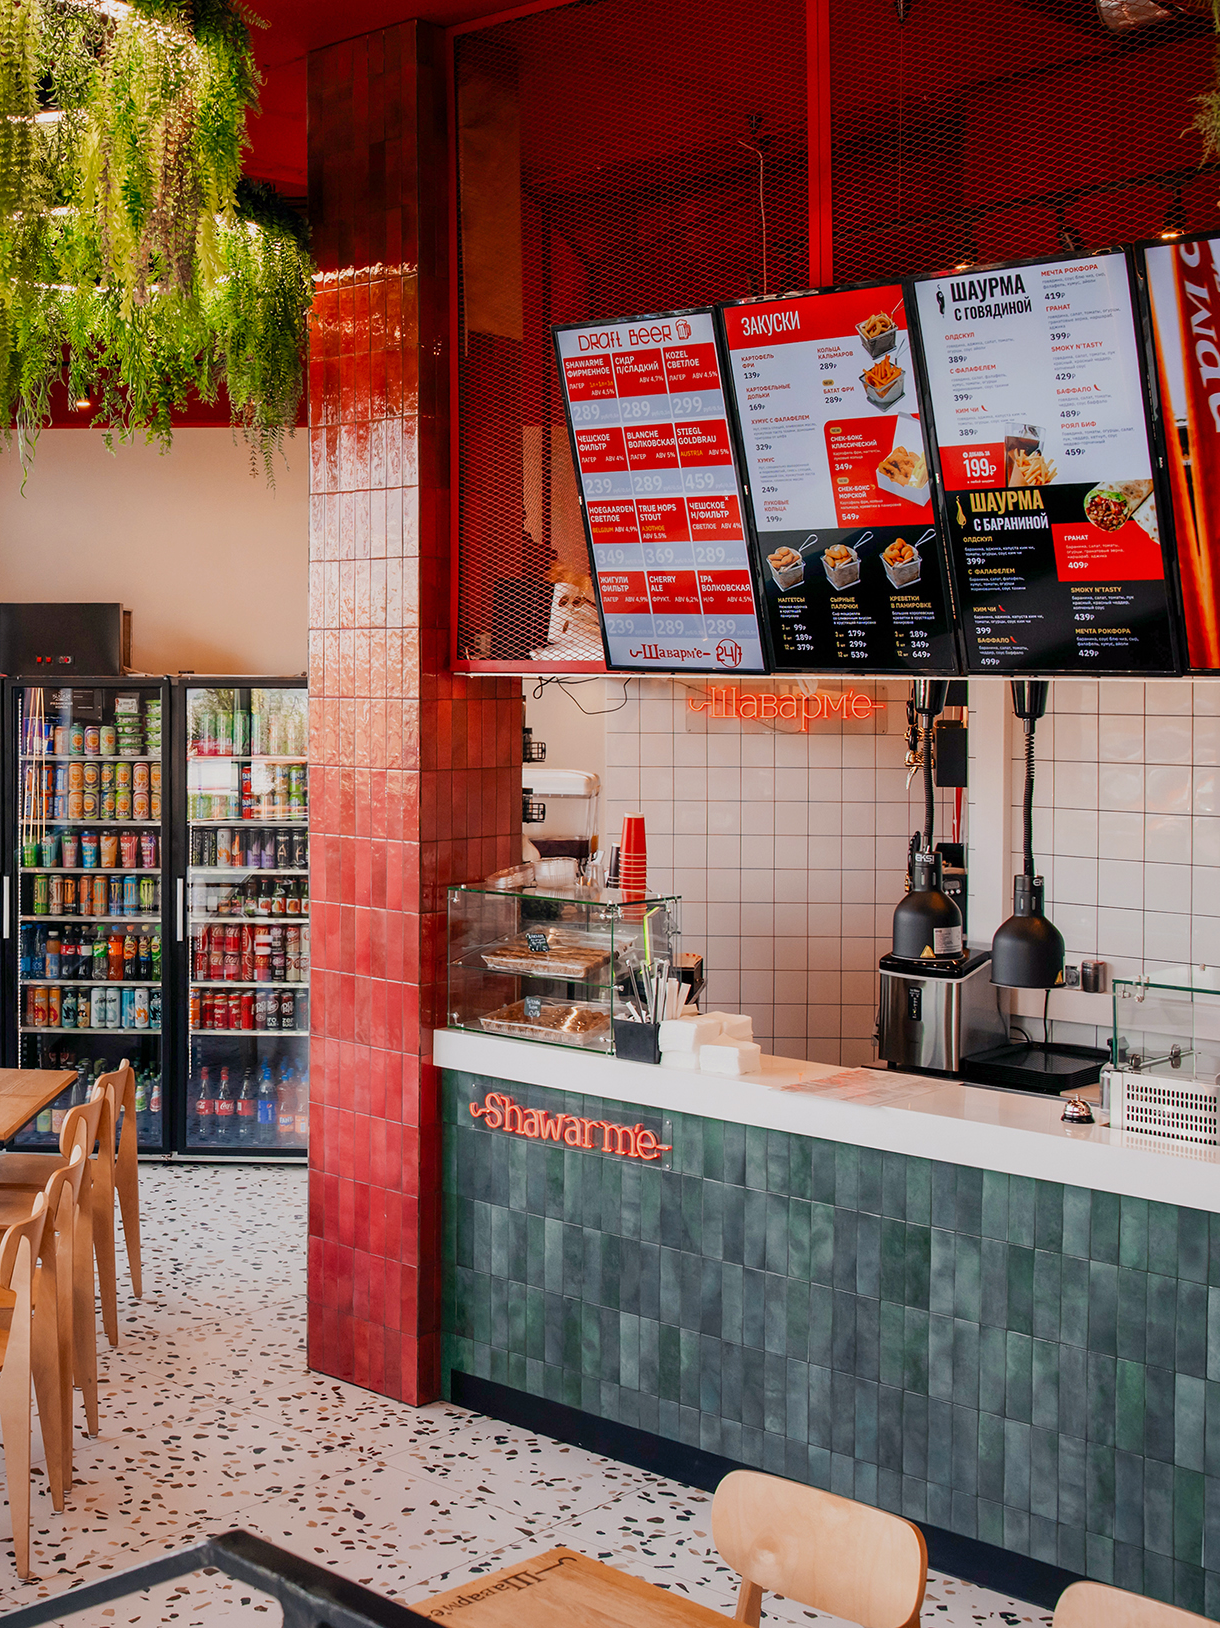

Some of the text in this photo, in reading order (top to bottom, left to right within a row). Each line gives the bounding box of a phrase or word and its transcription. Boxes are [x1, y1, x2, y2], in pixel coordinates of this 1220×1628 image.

[1041, 264, 1098, 277] МЕЧТА РОКФОРА
[950, 274, 1026, 303] ШАУРМА
[954, 308, 962, 321] С
[964, 296, 1032, 320] ГОВЯДИНОЙ
[1046, 304, 1071, 312] ГРАНАТ
[741, 310, 801, 337] ЗАКУСКИ
[945, 332, 975, 341] ОЛДСКУЛ
[817, 346, 841, 354] КОЛЬЦА
[1051, 344, 1074, 352] SMOKY
[615, 356, 635, 365] СИДР
[665, 351, 688, 360] KOZEL
[741, 353, 774, 362] КАРТОФЕЛЬ
[818, 351, 854, 360] КАЛЬМАРОВ
[565, 358, 604, 369] SHAWARME
[616, 361, 659, 374] П/СЛАДКИЙ
[667, 359, 700, 369] СВЕТЛОЕ
[567, 367, 610, 378] ФИРМЕННОЕ
[955, 364, 996, 374] ФАЛАФЕЛЕМ
[669, 374, 686, 382] ЛАГЕР
[746, 383, 791, 393] КАРТОФЕЛЬНЫЕ
[1057, 386, 1092, 395] БАФФАЛО
[747, 392, 770, 401] ДОЛЬКИ
[622, 401, 651, 419] 289
[673, 396, 702, 414] 299
[573, 404, 600, 421] 289
[751, 414, 810, 425] ХУМУС ФАЛАФЕЛЕМ
[627, 430, 659, 440] BLANCHE
[677, 427, 702, 436] STIEGL
[578, 434, 610, 442] ЧЕШСКОЕ
[628, 437, 676, 449] ВОЛКОВСКАЯ
[678, 435, 717, 445] GOLDBRAU
[579, 443, 607, 452] ФИЛЬТР
[832, 440, 877, 450] КЛАССИЧЕСКИЙ
[582, 456, 597, 464] ЛАГЕР
[585, 478, 612, 494] 239
[634, 475, 662, 493] 289
[685, 472, 714, 491] 459
[839, 491, 867, 499] МОРСКОЙ
[689, 502, 726, 510] ЧЕШСКОЕ
[969, 490, 1045, 515] ШАУРМА
[589, 505, 634, 514] HOEGAARDEN
[638, 504, 677, 513] TRUE HOPS
[591, 515, 621, 523] СВЕТЛОЕ
[640, 514, 662, 522] STOUT
[691, 510, 729, 519] Н/ФИЛЬТР
[974, 512, 1049, 531] С БАРАНИНОЙ
[597, 549, 624, 565] 349
[646, 548, 674, 564] 369
[696, 547, 725, 563] 289
[649, 576, 676, 584] CHERRY
[602, 584, 629, 592] ФИЛЬТР
[651, 584, 663, 592] ALE
[702, 584, 751, 592] ВОЛКОВСКАЯ
[607, 620, 635, 634] 239
[656, 620, 684, 635] 289
[707, 619, 736, 635] 289
